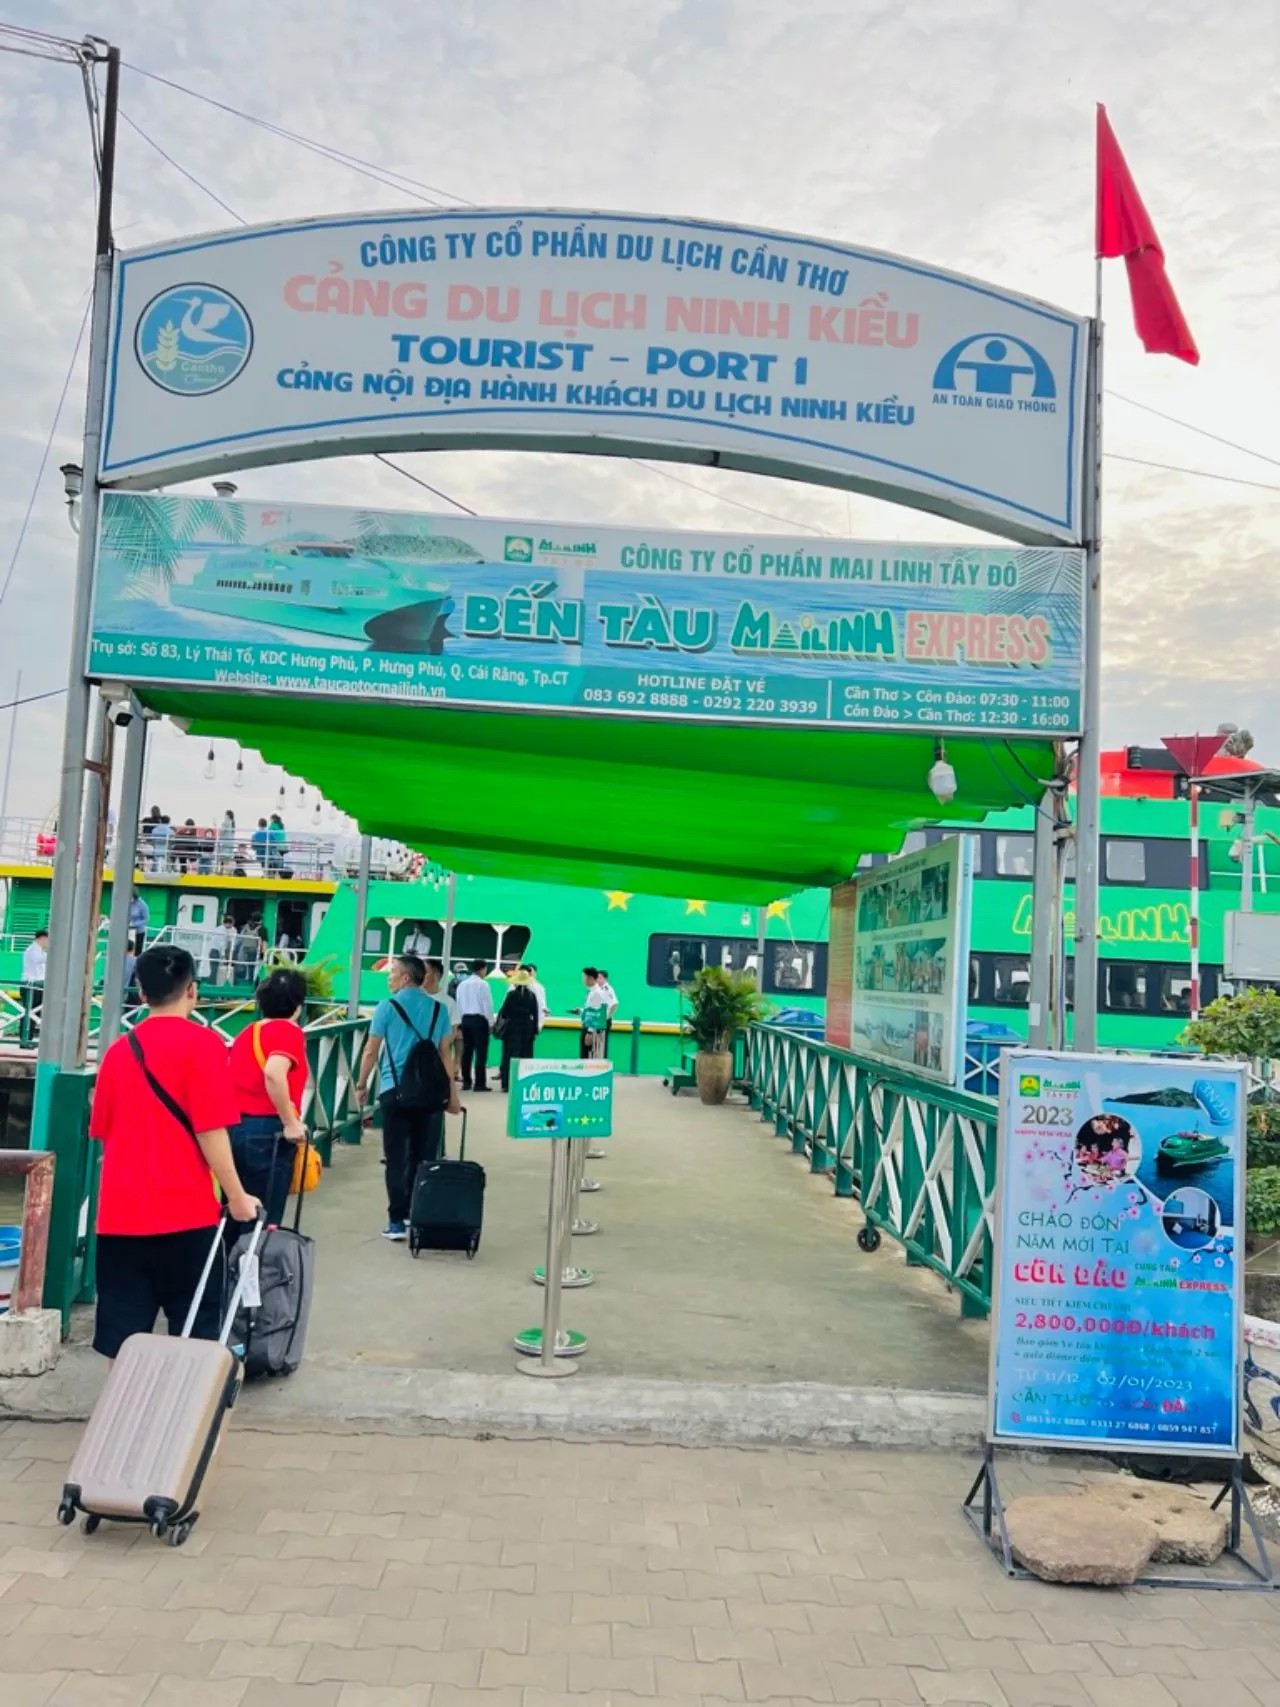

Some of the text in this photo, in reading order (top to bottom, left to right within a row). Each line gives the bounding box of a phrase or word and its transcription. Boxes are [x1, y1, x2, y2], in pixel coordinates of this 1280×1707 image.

[360, 234, 436, 267] CÔNG
[444, 233, 476, 259] TY
[485, 220, 523, 257] CỔ
[616, 234, 653, 261] DU
[661, 238, 723, 271] LỊCH
[730, 244, 789, 282] CẦN
[797, 260, 849, 296] THƠ
[284, 261, 920, 349] CẢNG DU LỊCH NINH KIỀU
[391, 333, 593, 372] TOURIST
[646, 346, 778, 382] PORT
[795, 357, 808, 385] 1
[277, 361, 915, 425] CẢNG NỘI ĐỊA HÀNH KHÁCH DU LỊCH NINH KIỀU
[932, 393, 948, 404] AN
[986, 397, 1014, 410] GIAO
[620, 543, 682, 571] CÔNG
[690, 550, 716, 573] TY
[723, 544, 754, 574] CỔ
[829, 556, 873, 580] MAI
[880, 559, 932, 584] LINH
[939, 558, 980, 586] TÂY
[987, 561, 1017, 587] ĐÔ
[464, 581, 583, 644] BẾN
[598, 593, 717, 652] TÀU
[906, 610, 1051, 666] EXPRESS
[92, 640, 113, 658] Trụ
[140, 641, 158, 657] Số
[160, 643, 180, 661] 83,
[186, 646, 201, 662] Lý
[204, 646, 232, 662] Thái
[260, 650, 287, 666] KDC
[291, 651, 326, 672] Hưng
[330, 655, 358, 673] Phú,
[363, 657, 374, 672] P.
[379, 659, 414, 678] Hưng
[418, 661, 447, 679] Phú,
[451, 663, 464, 681] Q.
[468, 664, 488, 680] Cái
[492, 666, 528, 687] Răng,
[532, 669, 568, 688] Tp.CT
[215, 668, 446, 698] Website: www.taucaotocmailinh.vn
[638, 674, 766, 695] HOTLINE ĐẶT VÉ
[583, 688, 612, 702] 083
[617, 690, 645, 705] 692
[650, 692, 688, 707] 8888
[703, 695, 741, 710] 0292
[746, 697, 774, 711] 220
[779, 699, 817, 714] 3939
[873, 687, 898, 700] Thơ
[903, 691, 912, 700] >
[916, 689, 941, 703] Côn
[945, 690, 976, 705] Đảo:
[979, 692, 1018, 706] 07:30
[1031, 695, 1070, 708] 11:00
[843, 703, 869, 718] Côn
[873, 704, 898, 719] Đảo
[903, 709, 913, 719] >
[946, 709, 976, 722] Thơ:
[979, 710, 1017, 723] 12:30
[1031, 712, 1069, 726] 16:00
[522, 1082, 541, 1101] LỐI
[543, 1086, 555, 1101] ĐI
[558, 1086, 582, 1101] V.I.P
[592, 1086, 610, 1101] CIP
[1022, 1104, 1074, 1126] 2023
[1178, 1280, 1227, 1292] EXPRESS
